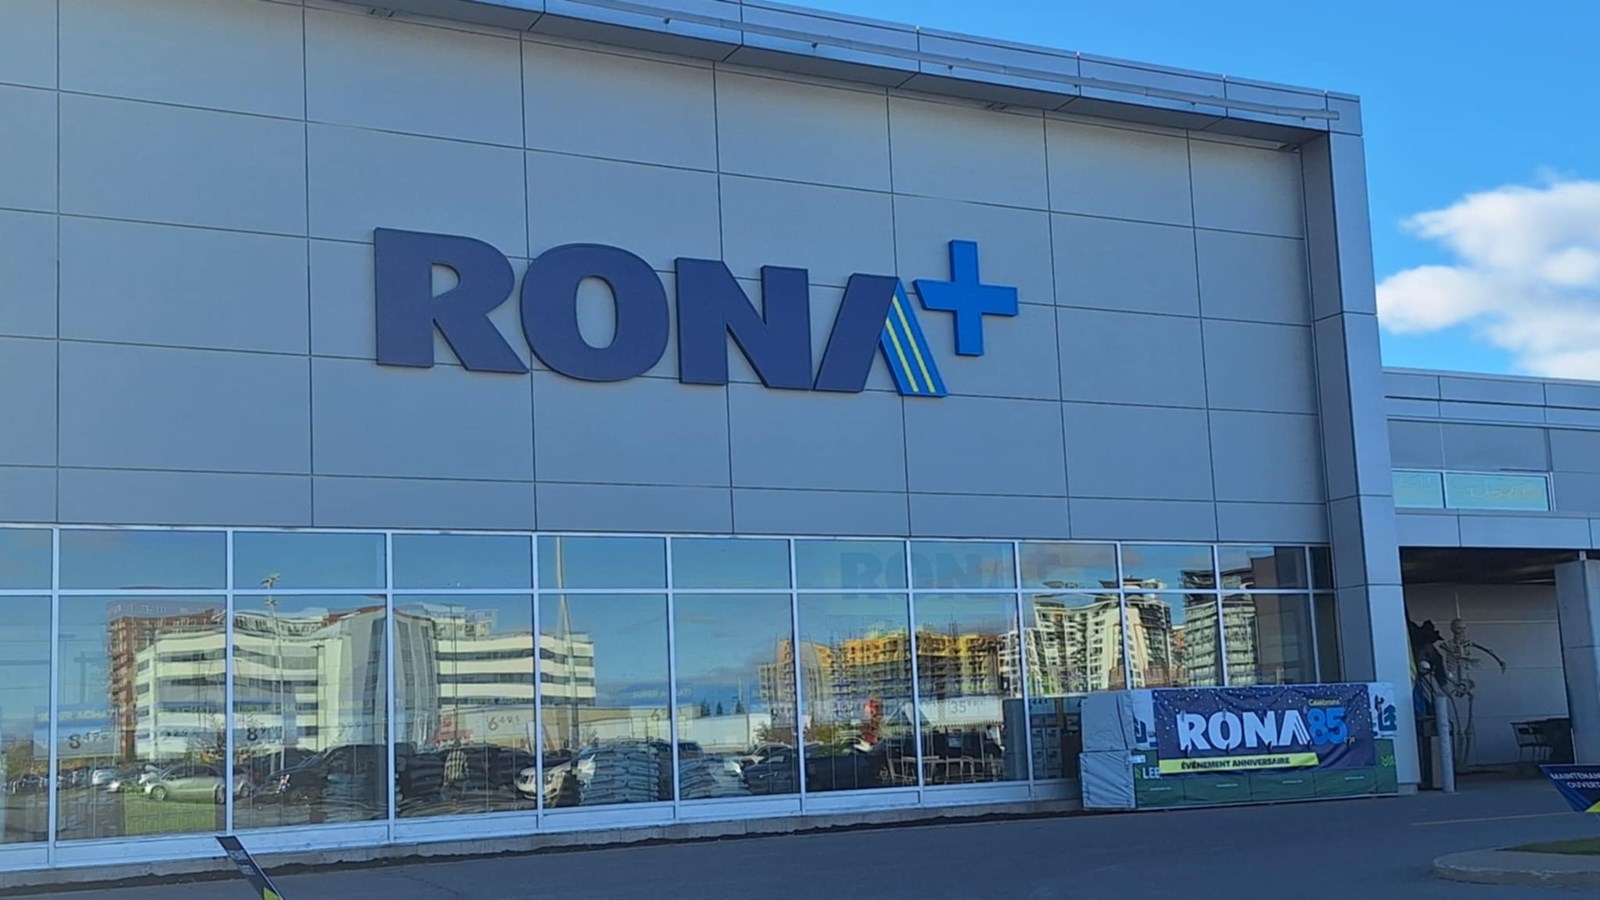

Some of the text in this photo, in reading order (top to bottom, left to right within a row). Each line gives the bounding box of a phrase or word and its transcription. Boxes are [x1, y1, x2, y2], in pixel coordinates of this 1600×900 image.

[1176, 707, 1348, 751] RONA 85
[1180, 757, 1291, 770] ÉVÉNEMENT ANNIVERSAIRE
